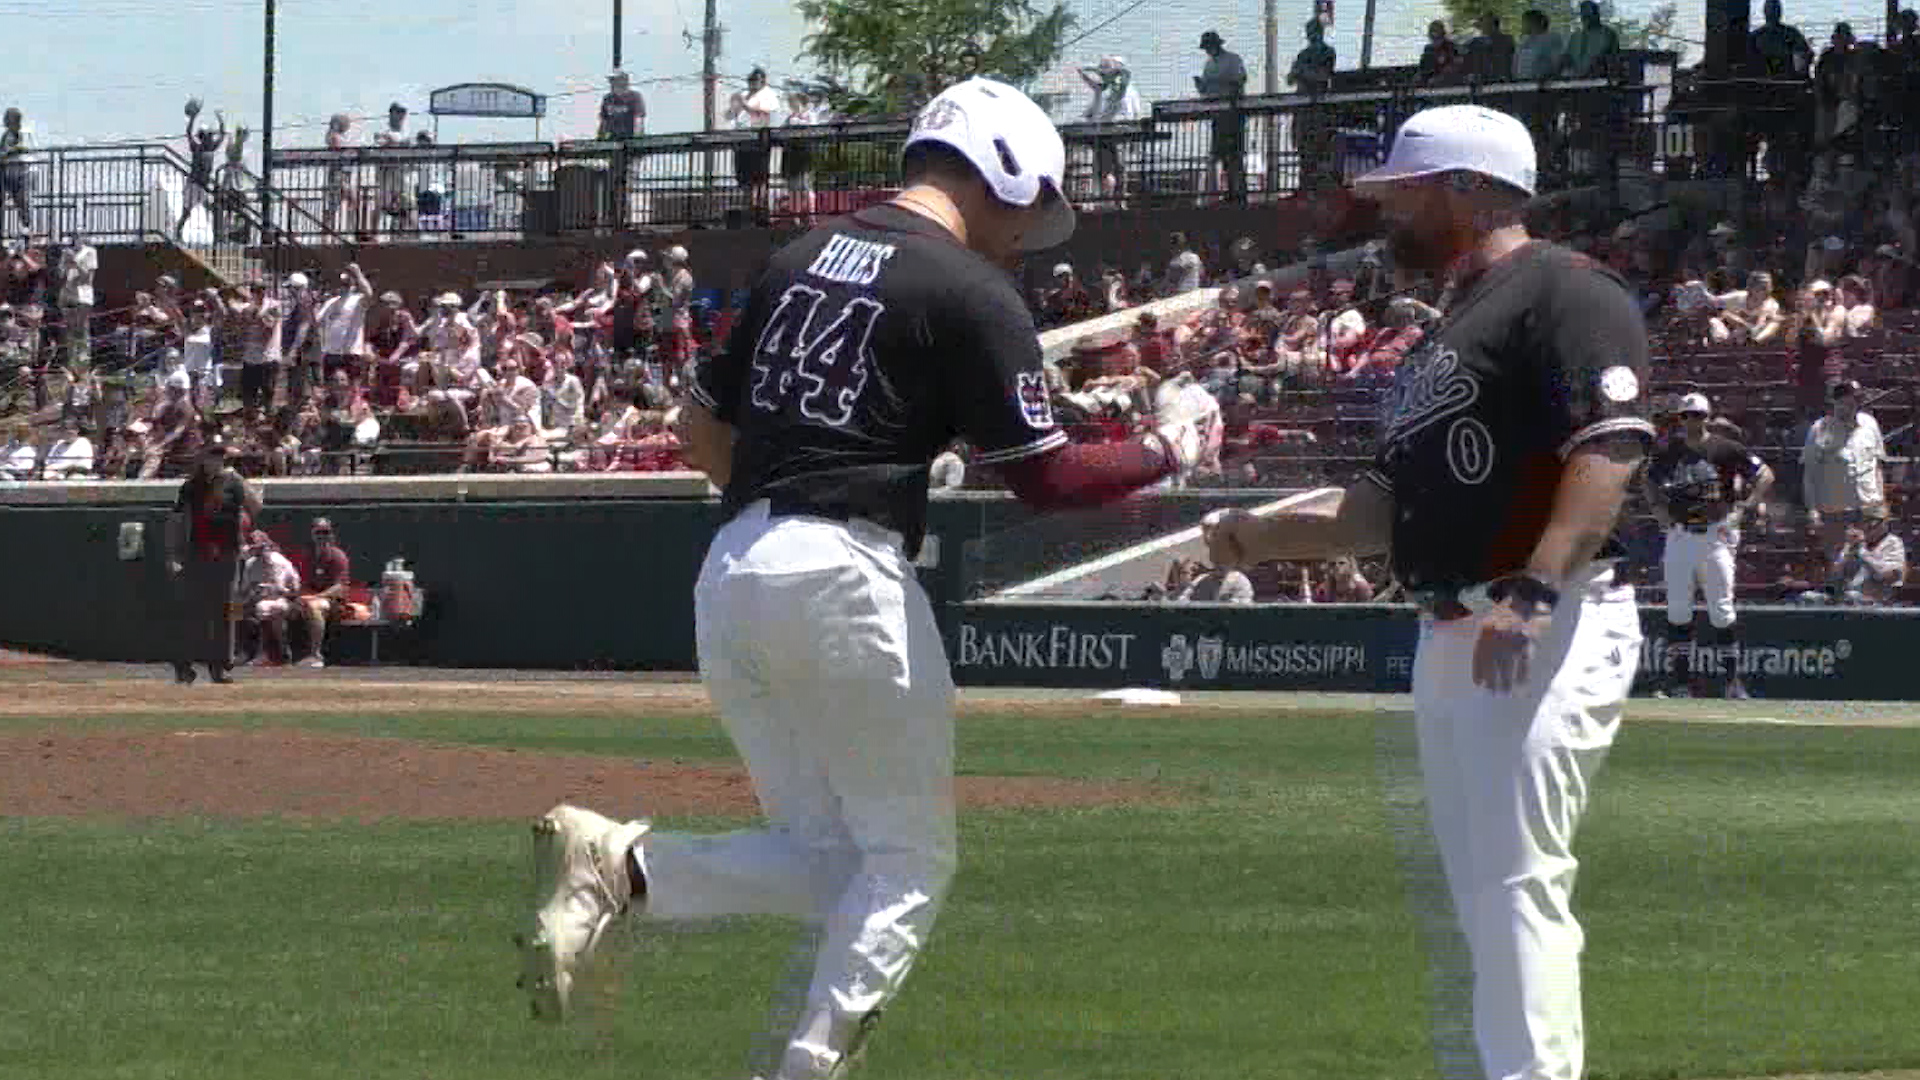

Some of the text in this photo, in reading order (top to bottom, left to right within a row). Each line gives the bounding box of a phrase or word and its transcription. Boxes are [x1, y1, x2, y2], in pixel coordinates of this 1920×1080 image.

[1653, 123, 1696, 159] 101
[806, 233, 896, 284] HINES
[752, 284, 884, 426] 44
[1447, 417, 1494, 484] 0
[1227, 644, 1366, 674] MISSISSIPPI
